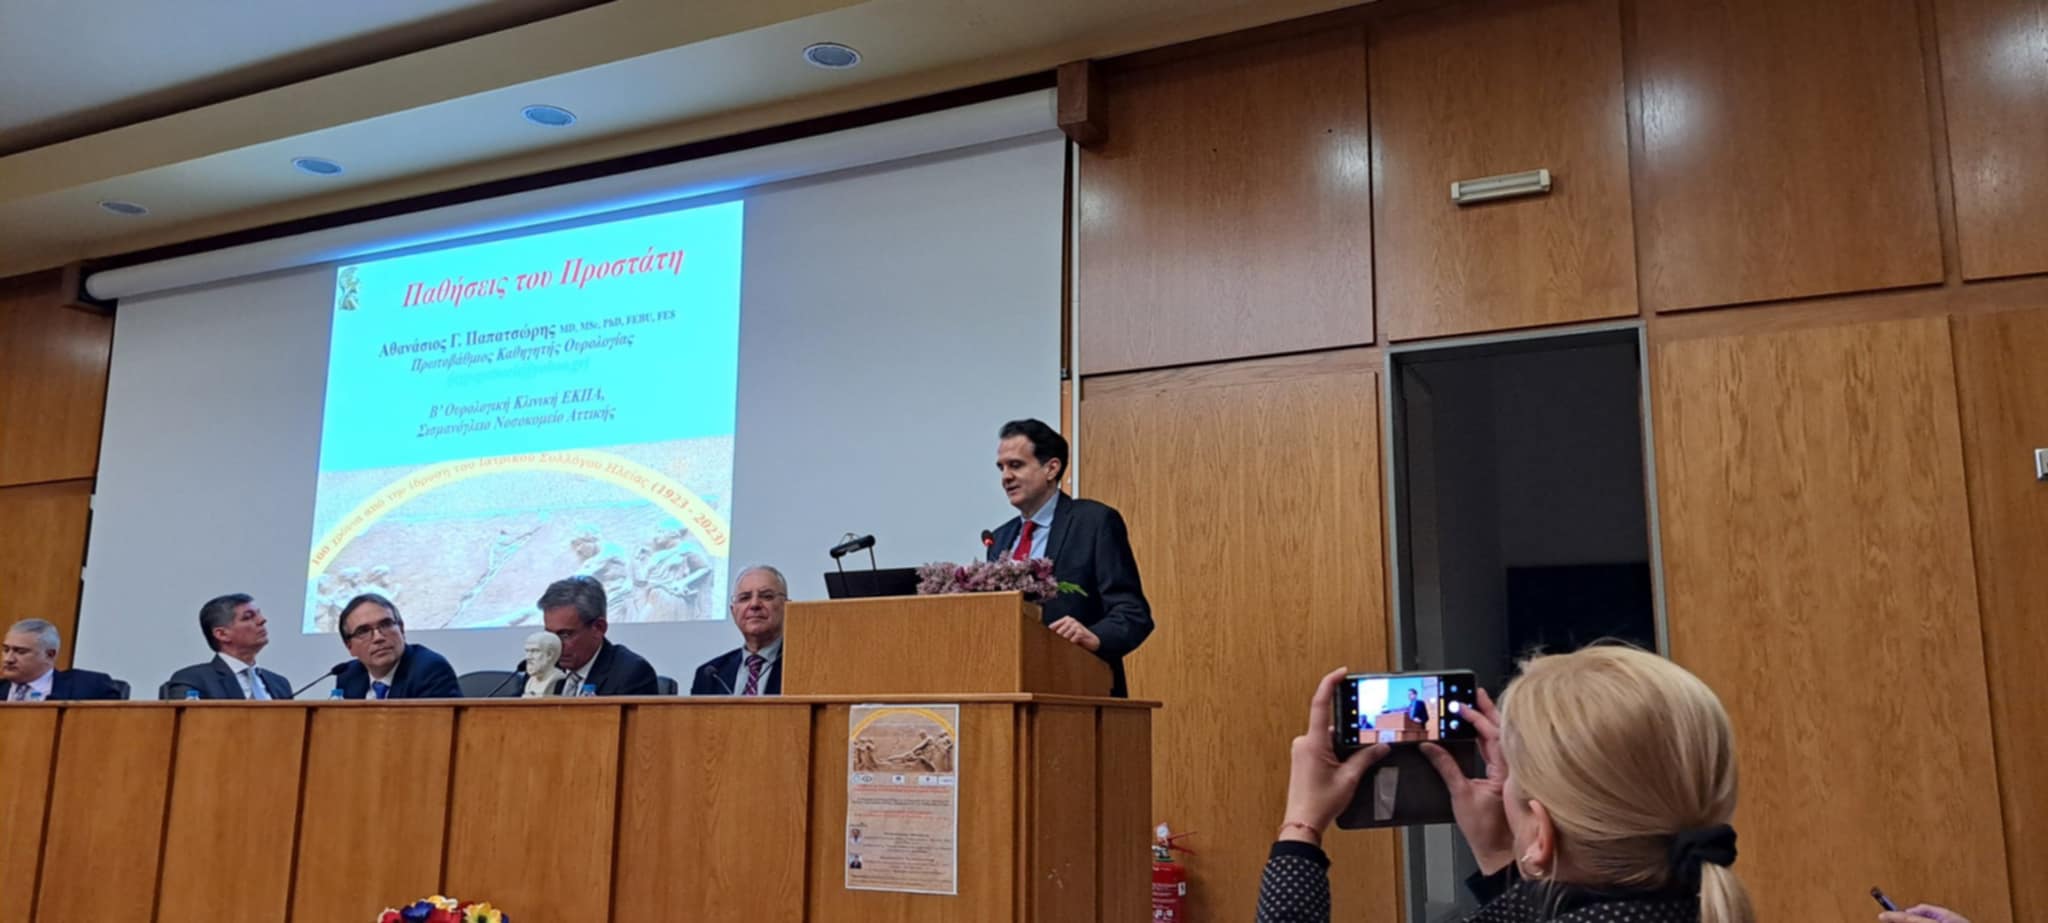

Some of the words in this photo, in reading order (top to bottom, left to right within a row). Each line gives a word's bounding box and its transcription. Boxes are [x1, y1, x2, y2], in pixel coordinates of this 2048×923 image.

[402, 273, 509, 308] Παθήσεις
[516, 271, 553, 292] του
[560, 246, 685, 289] Προστάτη
[379, 337, 447, 358] Αθανάσιος
[450, 332, 462, 348] Γ.
[466, 323, 556, 346] Παπατσώρης
[411, 352, 494, 374] Πρωτοβάθμιος
[496, 341, 561, 364] Καθηγητής
[564, 331, 635, 354] Ουρολογίας
[493, 411, 565, 431] Νοσοκομείο
[513, 392, 559, 411] Κλινική
[651, 481, 689, 509] (1923
[694, 513, 726, 546] 2023)
